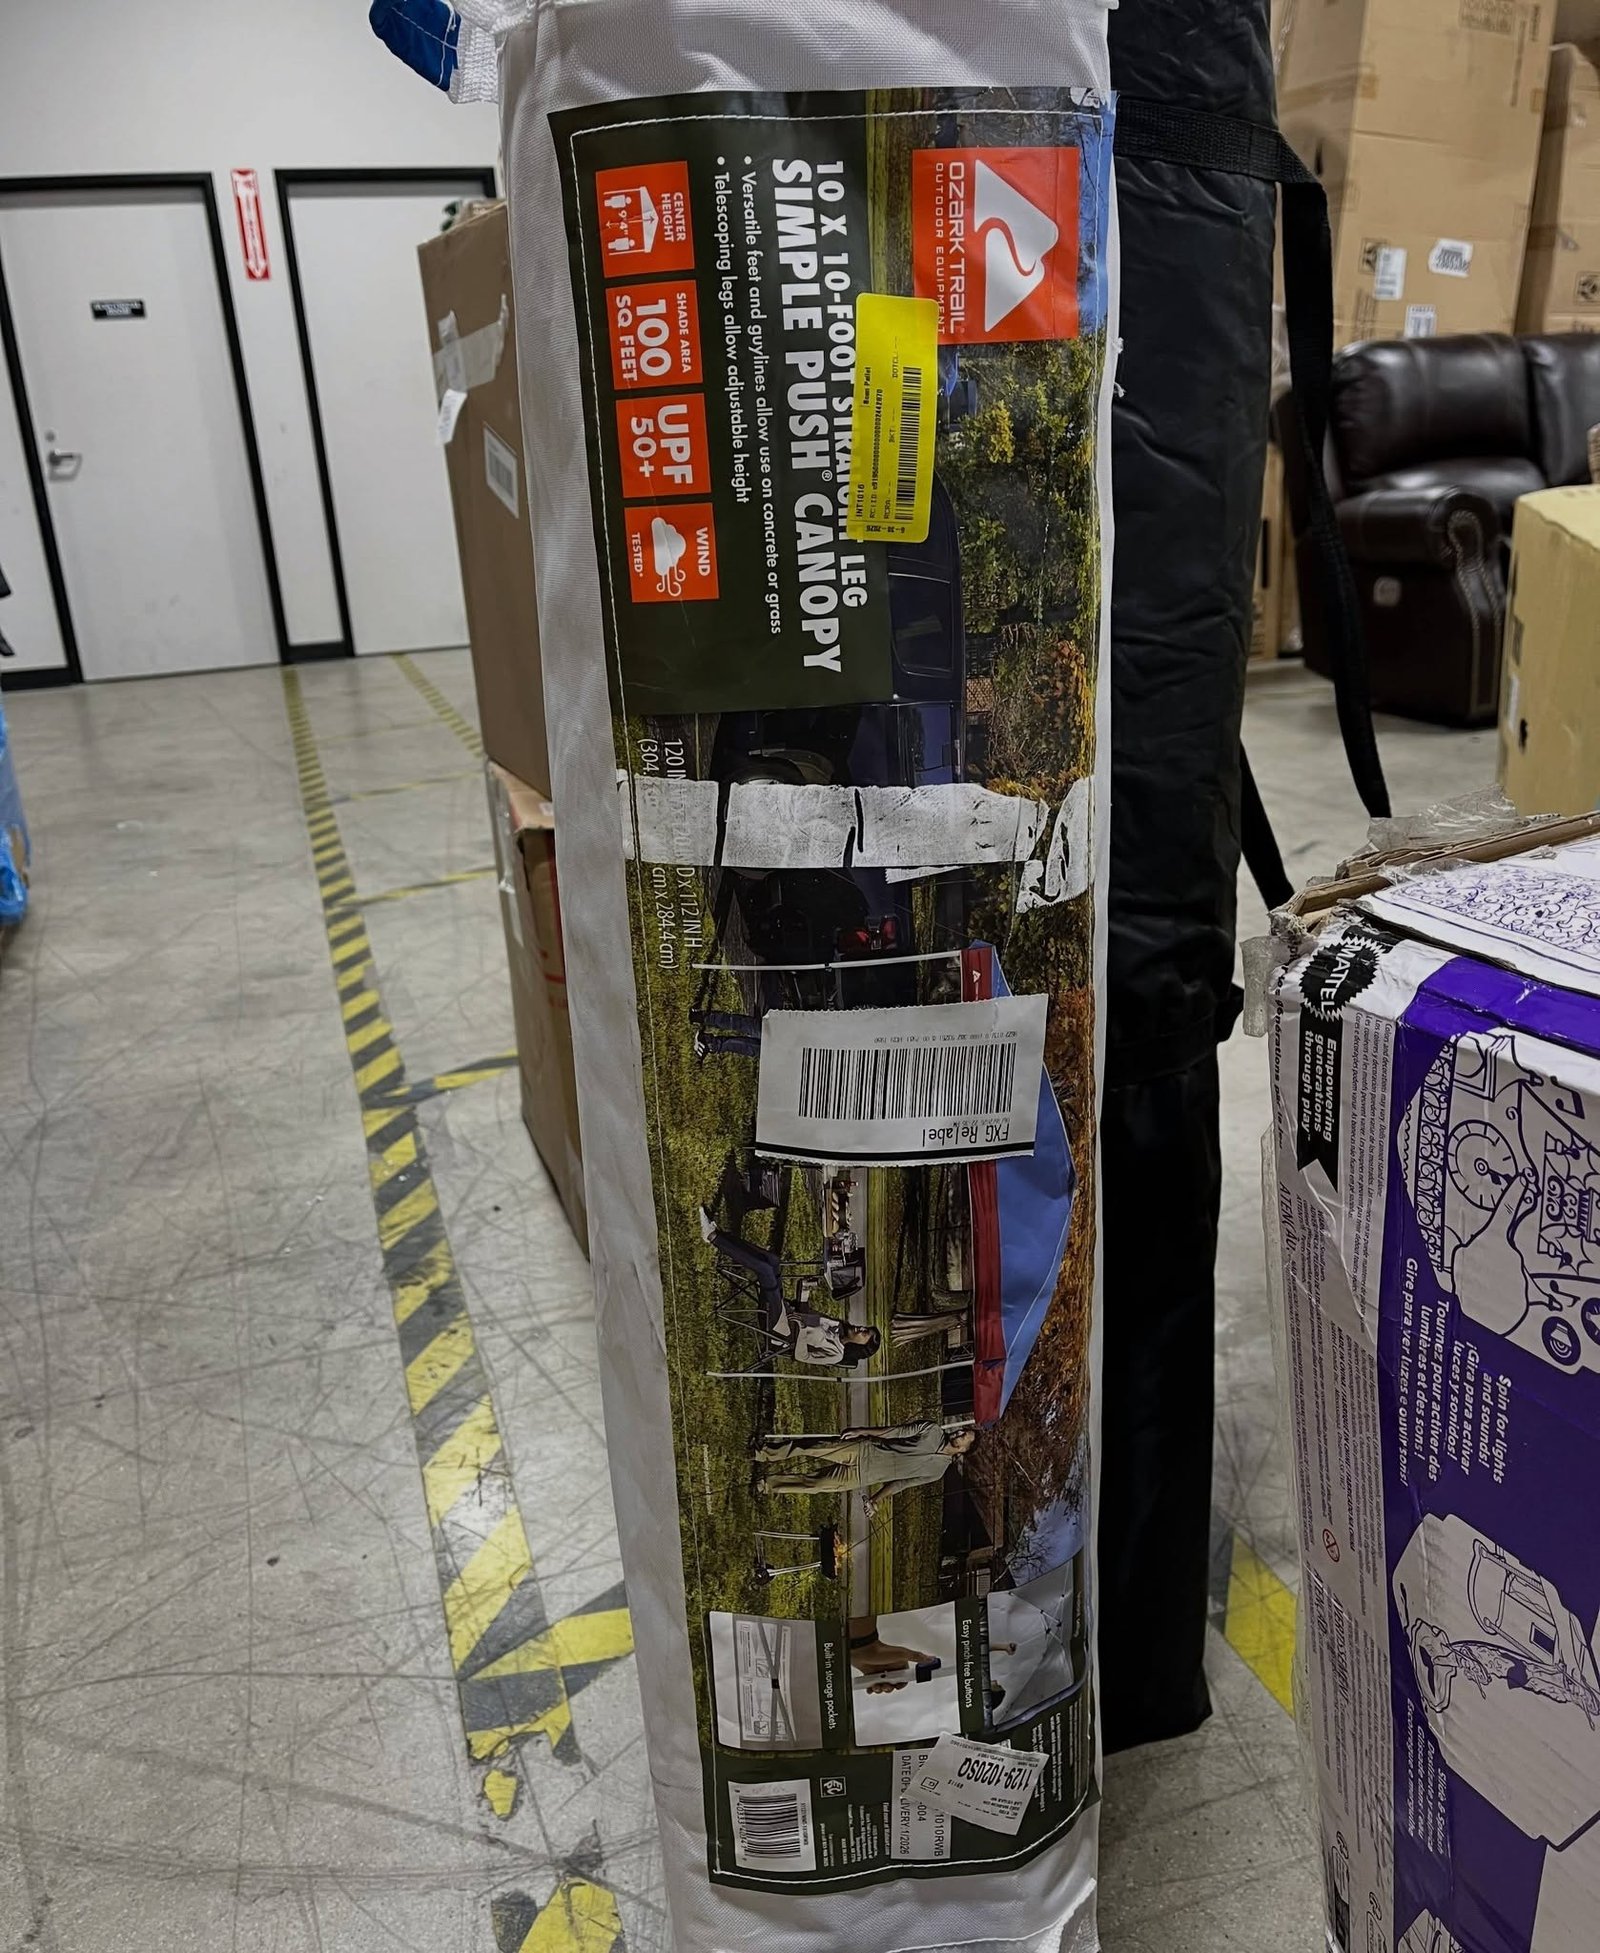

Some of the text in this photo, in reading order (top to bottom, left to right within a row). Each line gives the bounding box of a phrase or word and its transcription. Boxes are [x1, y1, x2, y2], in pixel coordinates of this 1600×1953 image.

[816, 160, 845, 208] 10
[661, 193, 675, 242] HEIGHT
[673, 192, 687, 241] CENTER
[821, 214, 847, 236] X
[771, 159, 825, 330] SIMPLE
[936, 246, 946, 335] EQUIPMENT
[615, 295, 637, 381] SQ FEET
[635, 298, 670, 377] 100
[676, 292, 691, 373] SHADE AREA
[713, 172, 751, 504] Telescoping legs allow adjustable height
[823, 253, 854, 383] 10-FOOT
[740, 172, 783, 634] Versatile feet and guylines allow use on concrete or grass
[631, 416, 655, 478] 50+
[657, 404, 693, 485] UPF
[696, 527, 711, 576] WIND
[794, 493, 842, 673] CANOPY
[839, 554, 867, 608] LEG
[663, 739, 702, 947] 120 IN D x 112 IN H
[651, 867, 668, 887] cm
[655, 891, 669, 899] x
[656, 903, 676, 940] 284.4
[659, 943, 679, 969] cm)
[1320, 943, 1362, 1014] MATTEL
[1354, 1012, 1362, 1029] Cores
[1364, 1015, 1372, 1027] Les
[1383, 1023, 1392, 1042] Colors
[1302, 1030, 1314, 1095] through
[1313, 1033, 1324, 1133] generations
[1352, 1069, 1360, 1091] podem
[1381, 1057, 1389, 1092] decorations
[1323, 1038, 1337, 1142] Empowering
[1358, 1092, 1366, 1117] peuvent
[1368, 1093, 1377, 1116] pueden
[1379, 1093, 1387, 1107] may
[922, 1123, 1009, 1147] FXG Relabel
[1369, 1135, 1376, 1144] de
[1417, 1305, 1433, 1369] lumières
[1398, 1258, 1418, 1487] Gire para ver luzes e ouvir sons!
[1416, 1372, 1427, 1388] et
[1428, 1300, 1450, 1482] Tournez pour activer des
[1415, 1390, 1426, 1415] des
[1446, 1340, 1465, 1460] luces y sonidos!
[1460, 1341, 1480, 1476] ¡Gira para activar
[1478, 1373, 1493, 1467] and sounds!
[1492, 1375, 1512, 1484] Spin for lights
[824, 1642, 838, 1729] Built-in storage pockets
[961, 1619, 974, 1708] Easy pinch-free buttons
[1406, 1698, 1414, 1769] Escorregue
[901, 1755, 911, 1775] DATE
[957, 1757, 1032, 1791] 1129-1020SQ
[1426, 1795, 1432, 1807] y
[1438, 1802, 1445, 1813] &
[934, 1809, 944, 1857] 1010RWB
[1436, 1812, 1445, 1855] Splash
